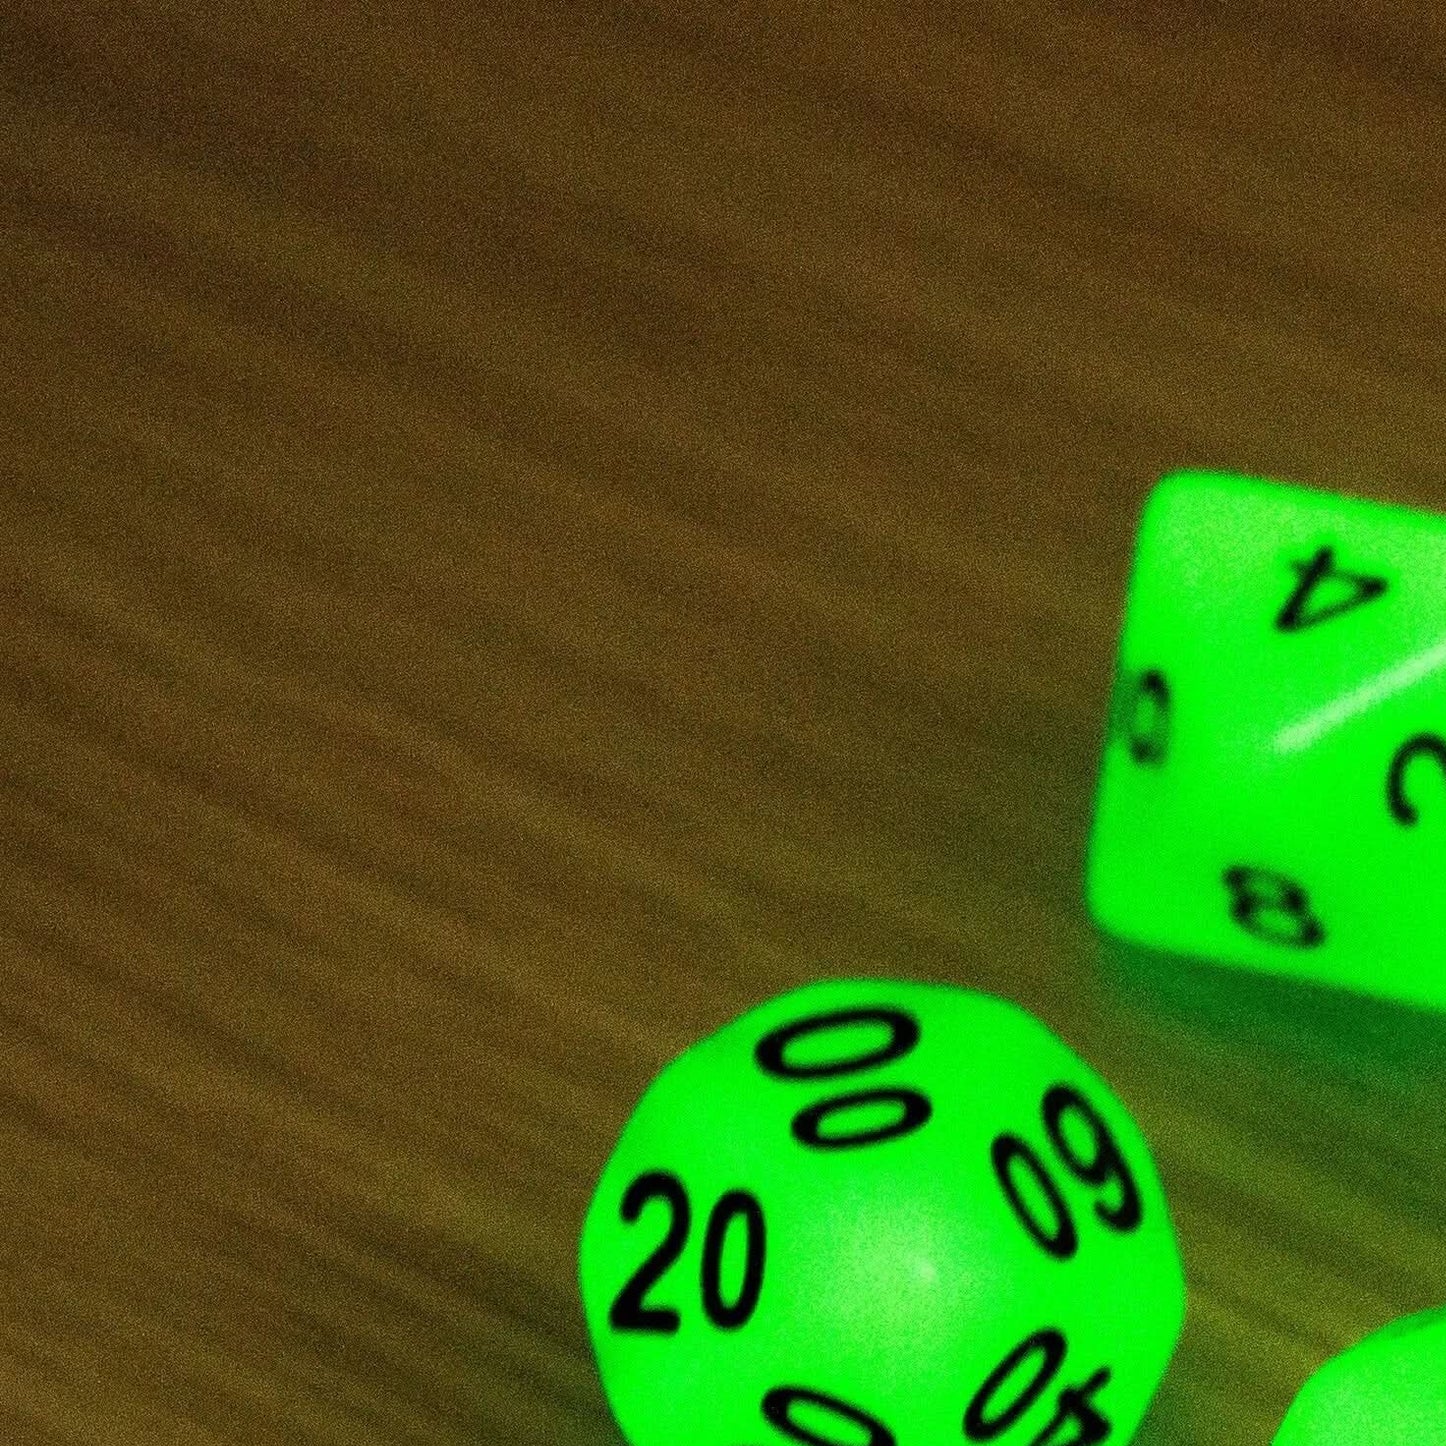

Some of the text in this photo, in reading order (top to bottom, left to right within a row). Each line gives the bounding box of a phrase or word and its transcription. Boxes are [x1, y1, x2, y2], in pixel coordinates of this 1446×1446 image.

[1274, 545, 1390, 633] 4
[752, 1003, 934, 1153] 00
[607, 1168, 768, 1335] 20
